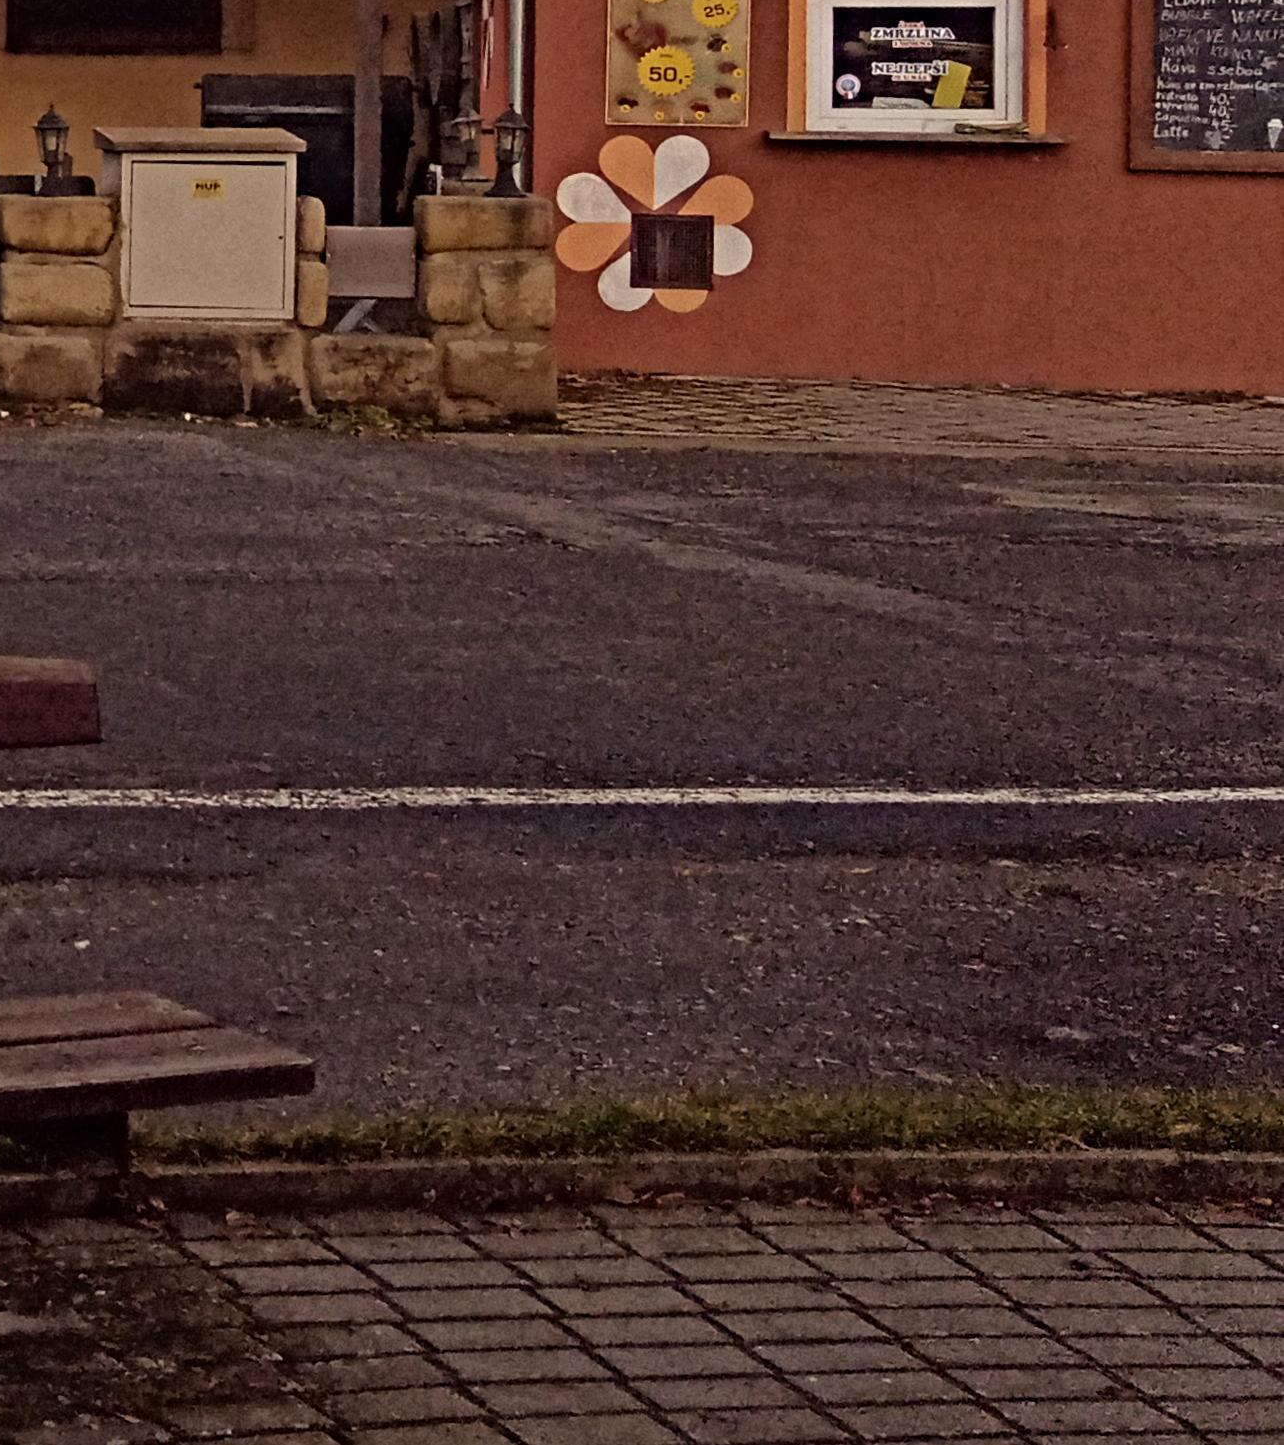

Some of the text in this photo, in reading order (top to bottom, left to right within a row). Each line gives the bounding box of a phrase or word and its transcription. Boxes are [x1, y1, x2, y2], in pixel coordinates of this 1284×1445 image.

[872, 28, 954, 39] ZMRZLINA
[873, 60, 948, 74] NEJLEPŠÍ
[649, 66, 691, 84] 50,-
